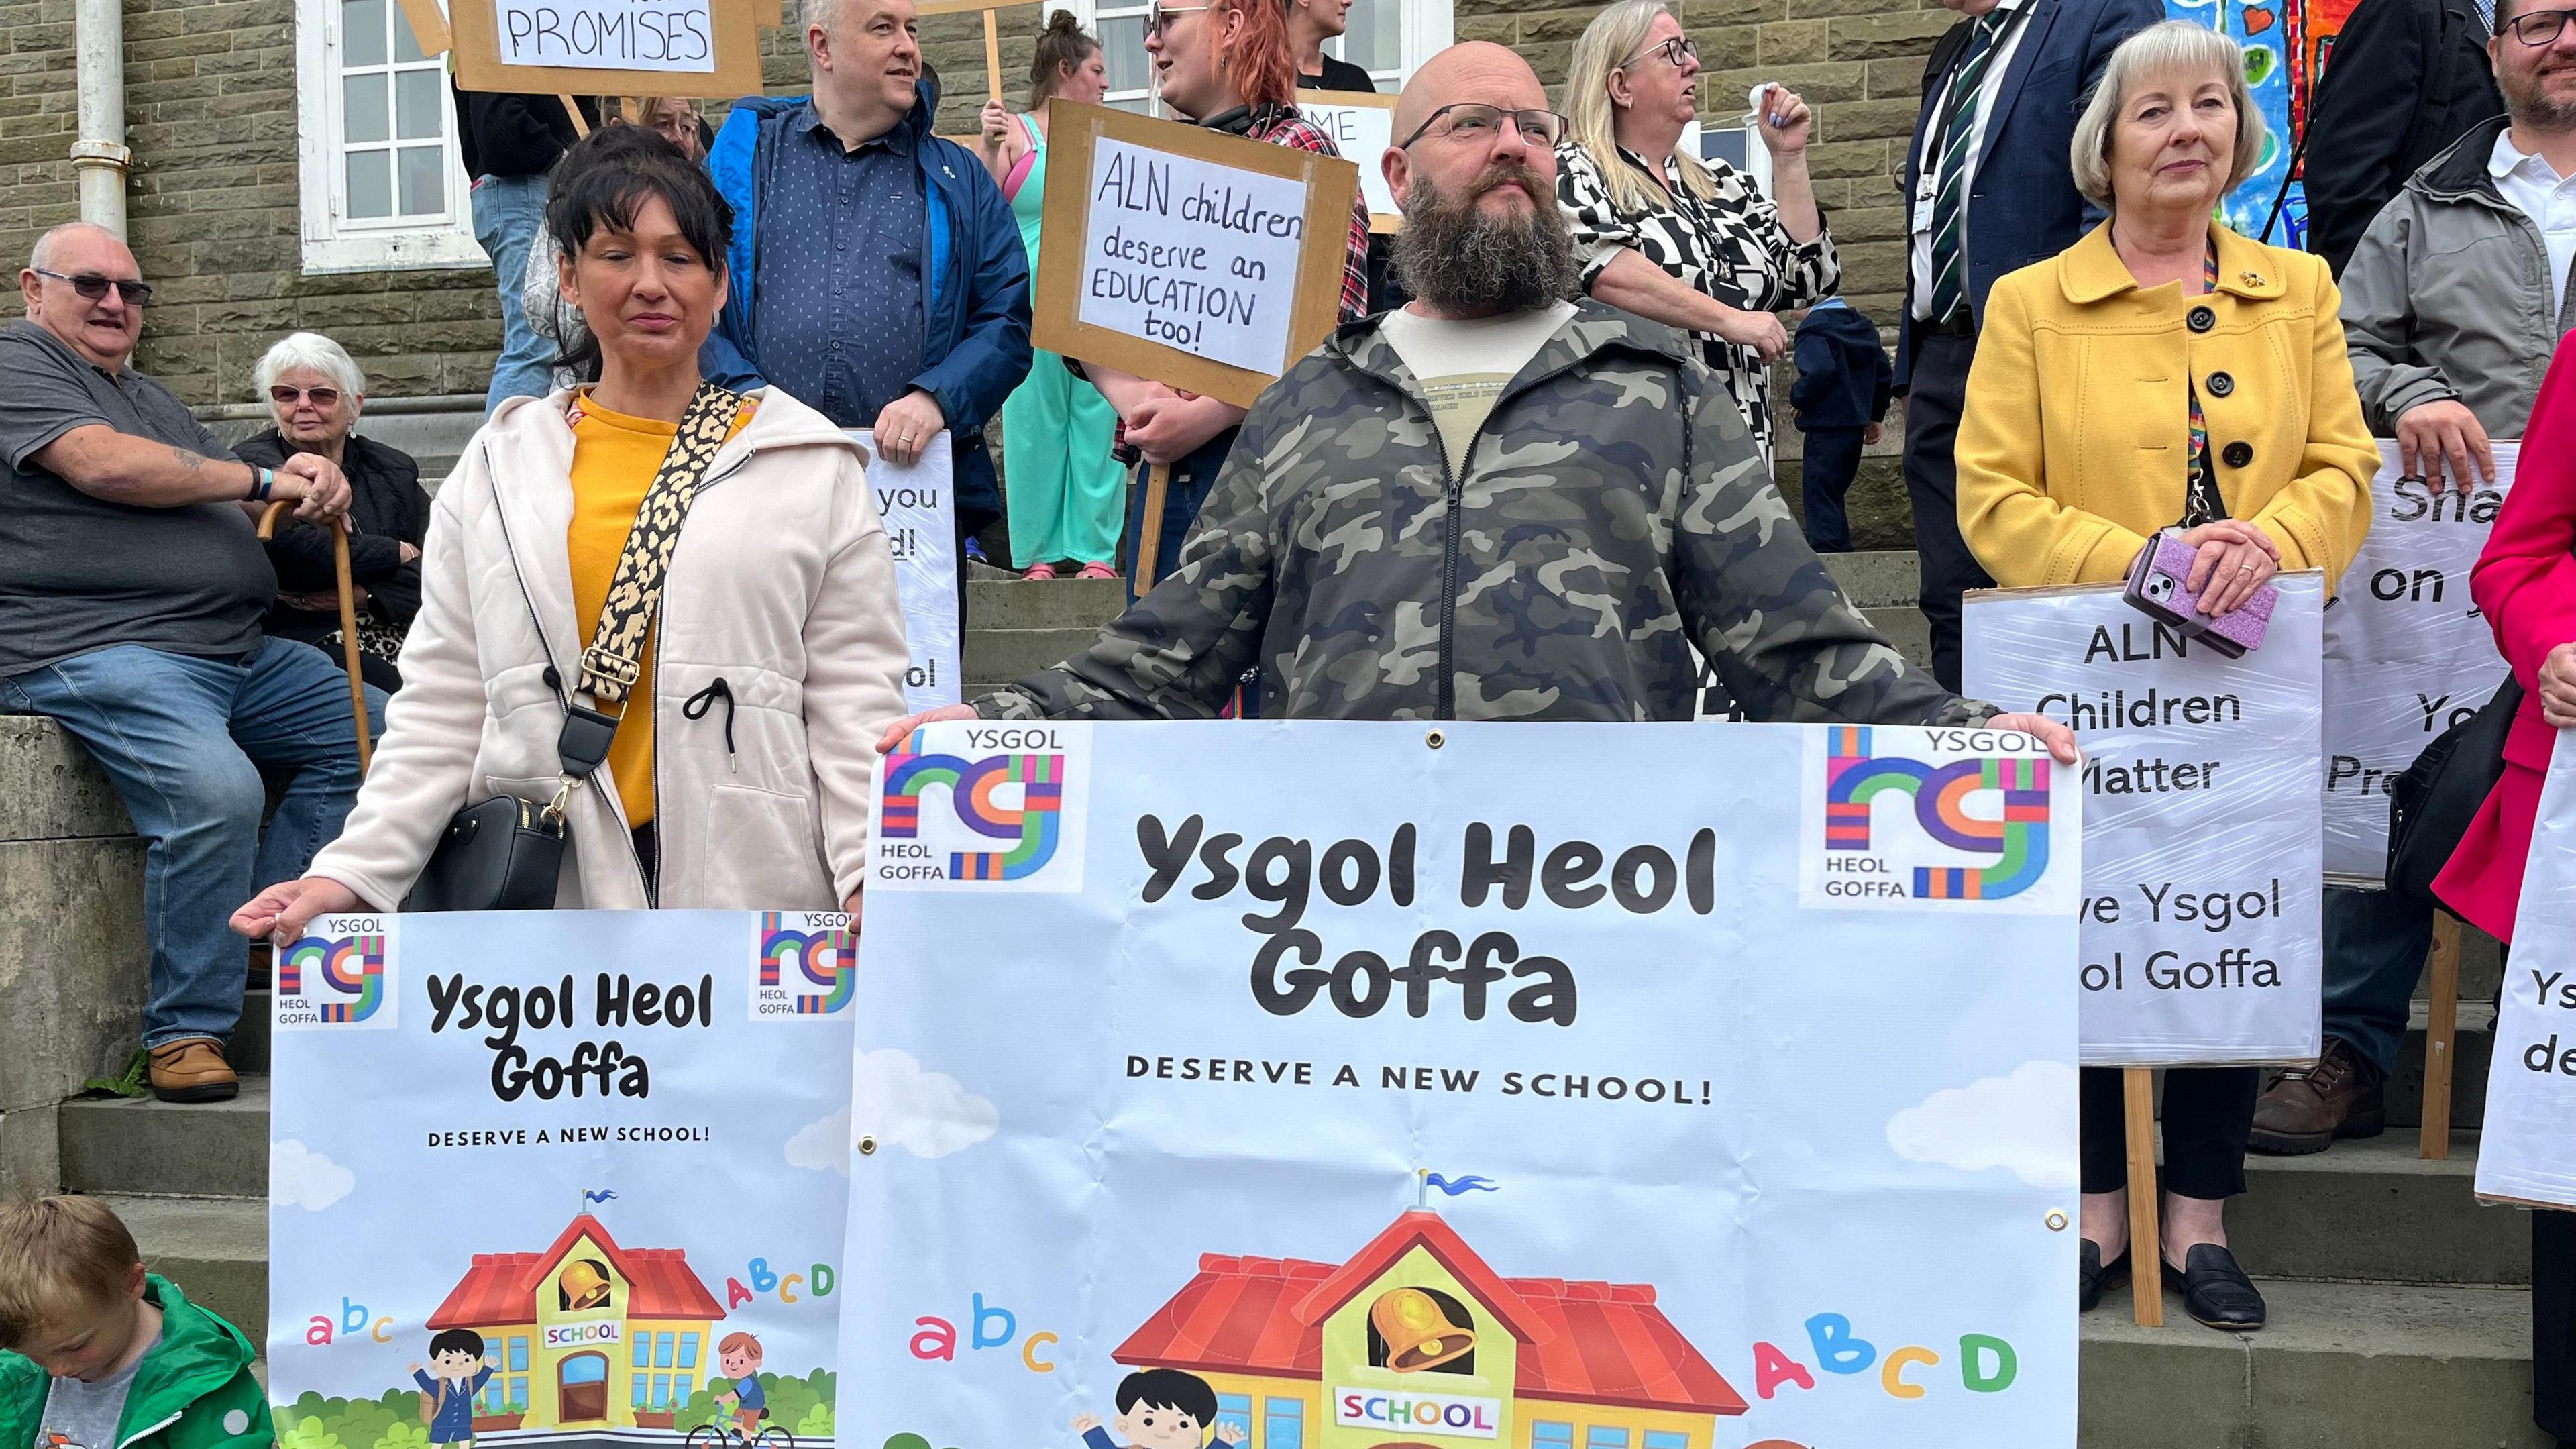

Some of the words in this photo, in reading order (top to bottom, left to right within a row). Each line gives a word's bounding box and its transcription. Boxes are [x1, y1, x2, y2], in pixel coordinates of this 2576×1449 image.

[508, 8, 708, 60] PROMISES
[1098, 152, 1169, 216] ALN
[1181, 182, 1303, 241] children
[1103, 225, 1208, 270] deserve
[1230, 255, 1265, 281] an
[1091, 268, 1256, 326] EDUCATION
[1144, 309, 1202, 352] too!
[877, 488, 937, 516] you
[2371, 567, 2444, 602] on
[2084, 623, 2188, 663] ALN
[906, 659, 936, 688] ol
[2036, 688, 2241, 730] Children
[966, 729, 1063, 750] YSGOL
[1925, 730, 2049, 752] YSGOL
[881, 844, 932, 859] HEOL
[1826, 857, 1890, 873] HEOL
[879, 865, 945, 881] GOFFA
[1136, 813, 1417, 934] Ysgol
[1460, 822, 1716, 916] Heol
[1825, 881, 1907, 898] GOFFA
[2138, 877, 2280, 932] Ysgol
[329, 918, 384, 933] YSGOL
[1250, 928, 1577, 1027] Goffa
[2080, 952, 2123, 991] ol
[2145, 948, 2282, 990] Goffa
[279, 999, 311, 1009] HEOL
[427, 972, 574, 1051] Ysgol
[596, 973, 712, 1028] Heol
[759, 989, 788, 1000] HEOL
[759, 1004, 794, 1014] GOFFA
[279, 1013, 319, 1024] GOFFA
[491, 1040, 650, 1102] Goffa
[1126, 1055, 1312, 1085] DESERVE
[1331, 1064, 1361, 1087] A
[1382, 1066, 1480, 1093] NEW
[1501, 1072, 1712, 1106] SCHOOL!
[428, 1129, 526, 1148] DESERVE
[535, 1129, 551, 1144] A
[561, 1126, 609, 1143] NEW
[616, 1126, 710, 1142] SCHOOL!
[547, 1324, 619, 1345] SCHOOL
[1344, 1395, 1493, 1430] SCHOOL
